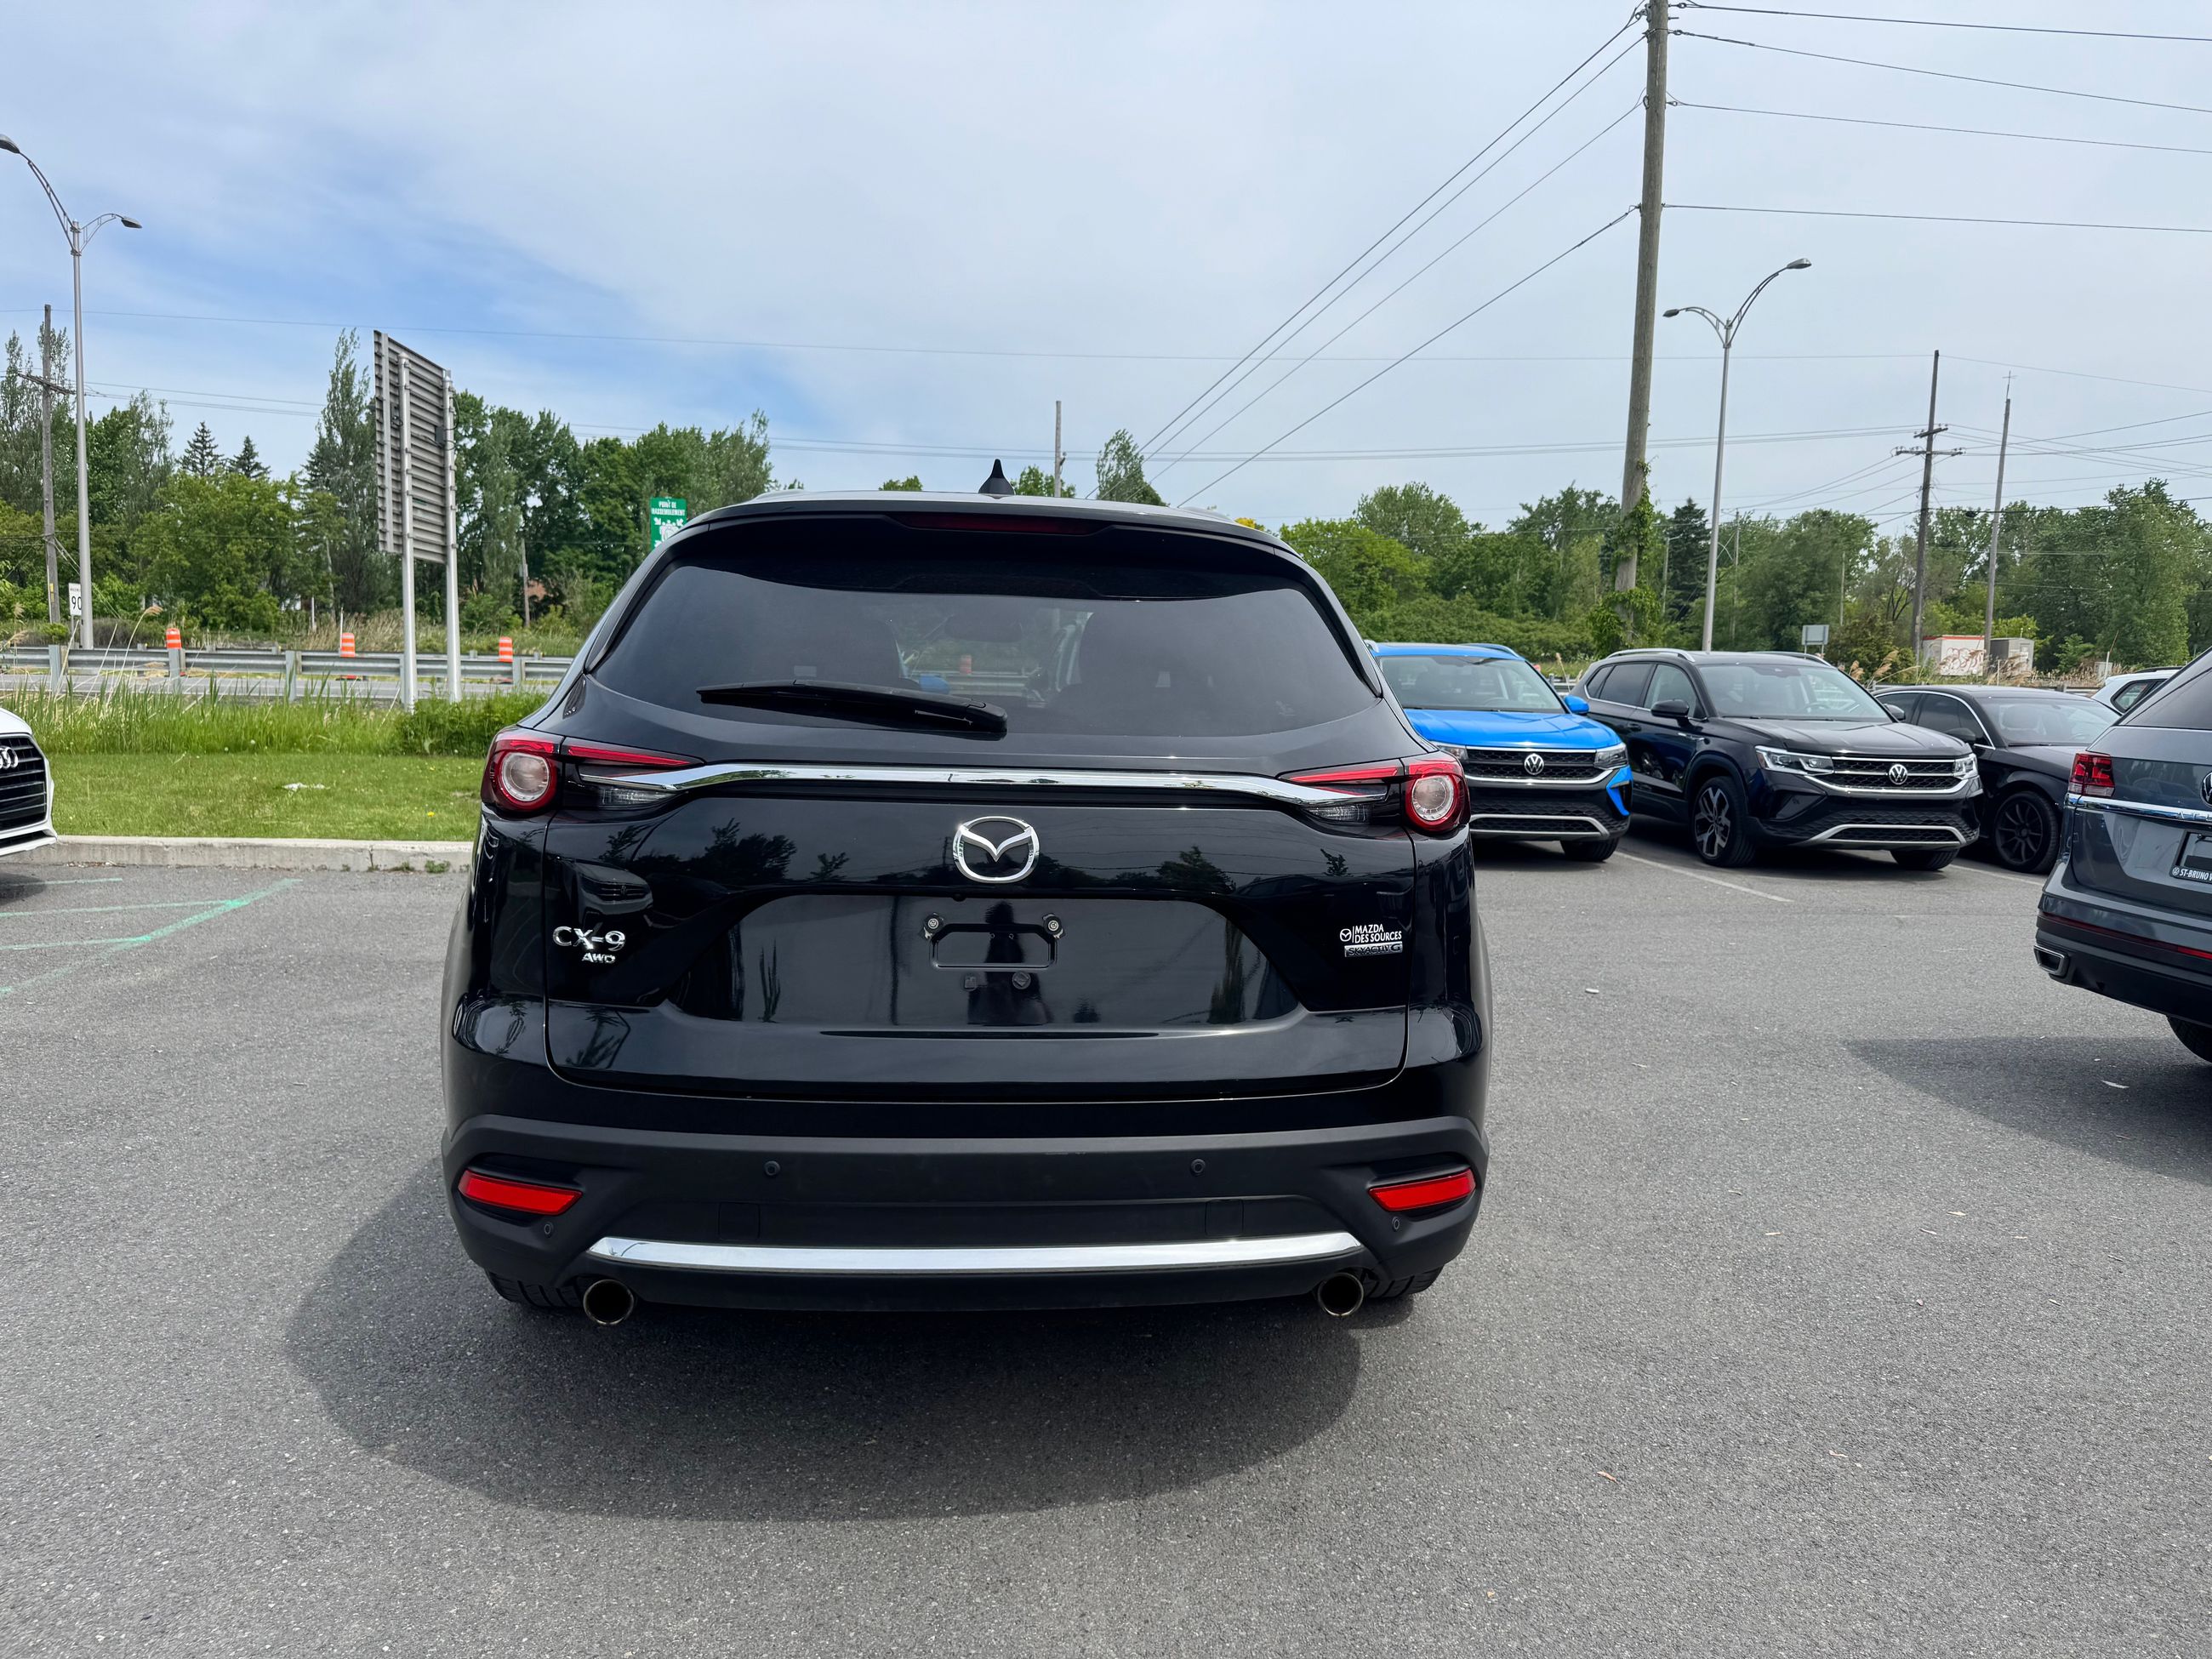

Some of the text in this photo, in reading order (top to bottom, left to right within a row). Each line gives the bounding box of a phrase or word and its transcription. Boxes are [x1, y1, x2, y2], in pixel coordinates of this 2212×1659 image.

[71, 596, 82, 610] 90
[2179, 868, 2209, 881] ST-BRUNO
[1354, 923, 1384, 934] MAZDA
[552, 926, 626, 951] CX-9
[1354, 931, 1402, 944] DES SOURCES
[581, 952, 616, 964] AWD
